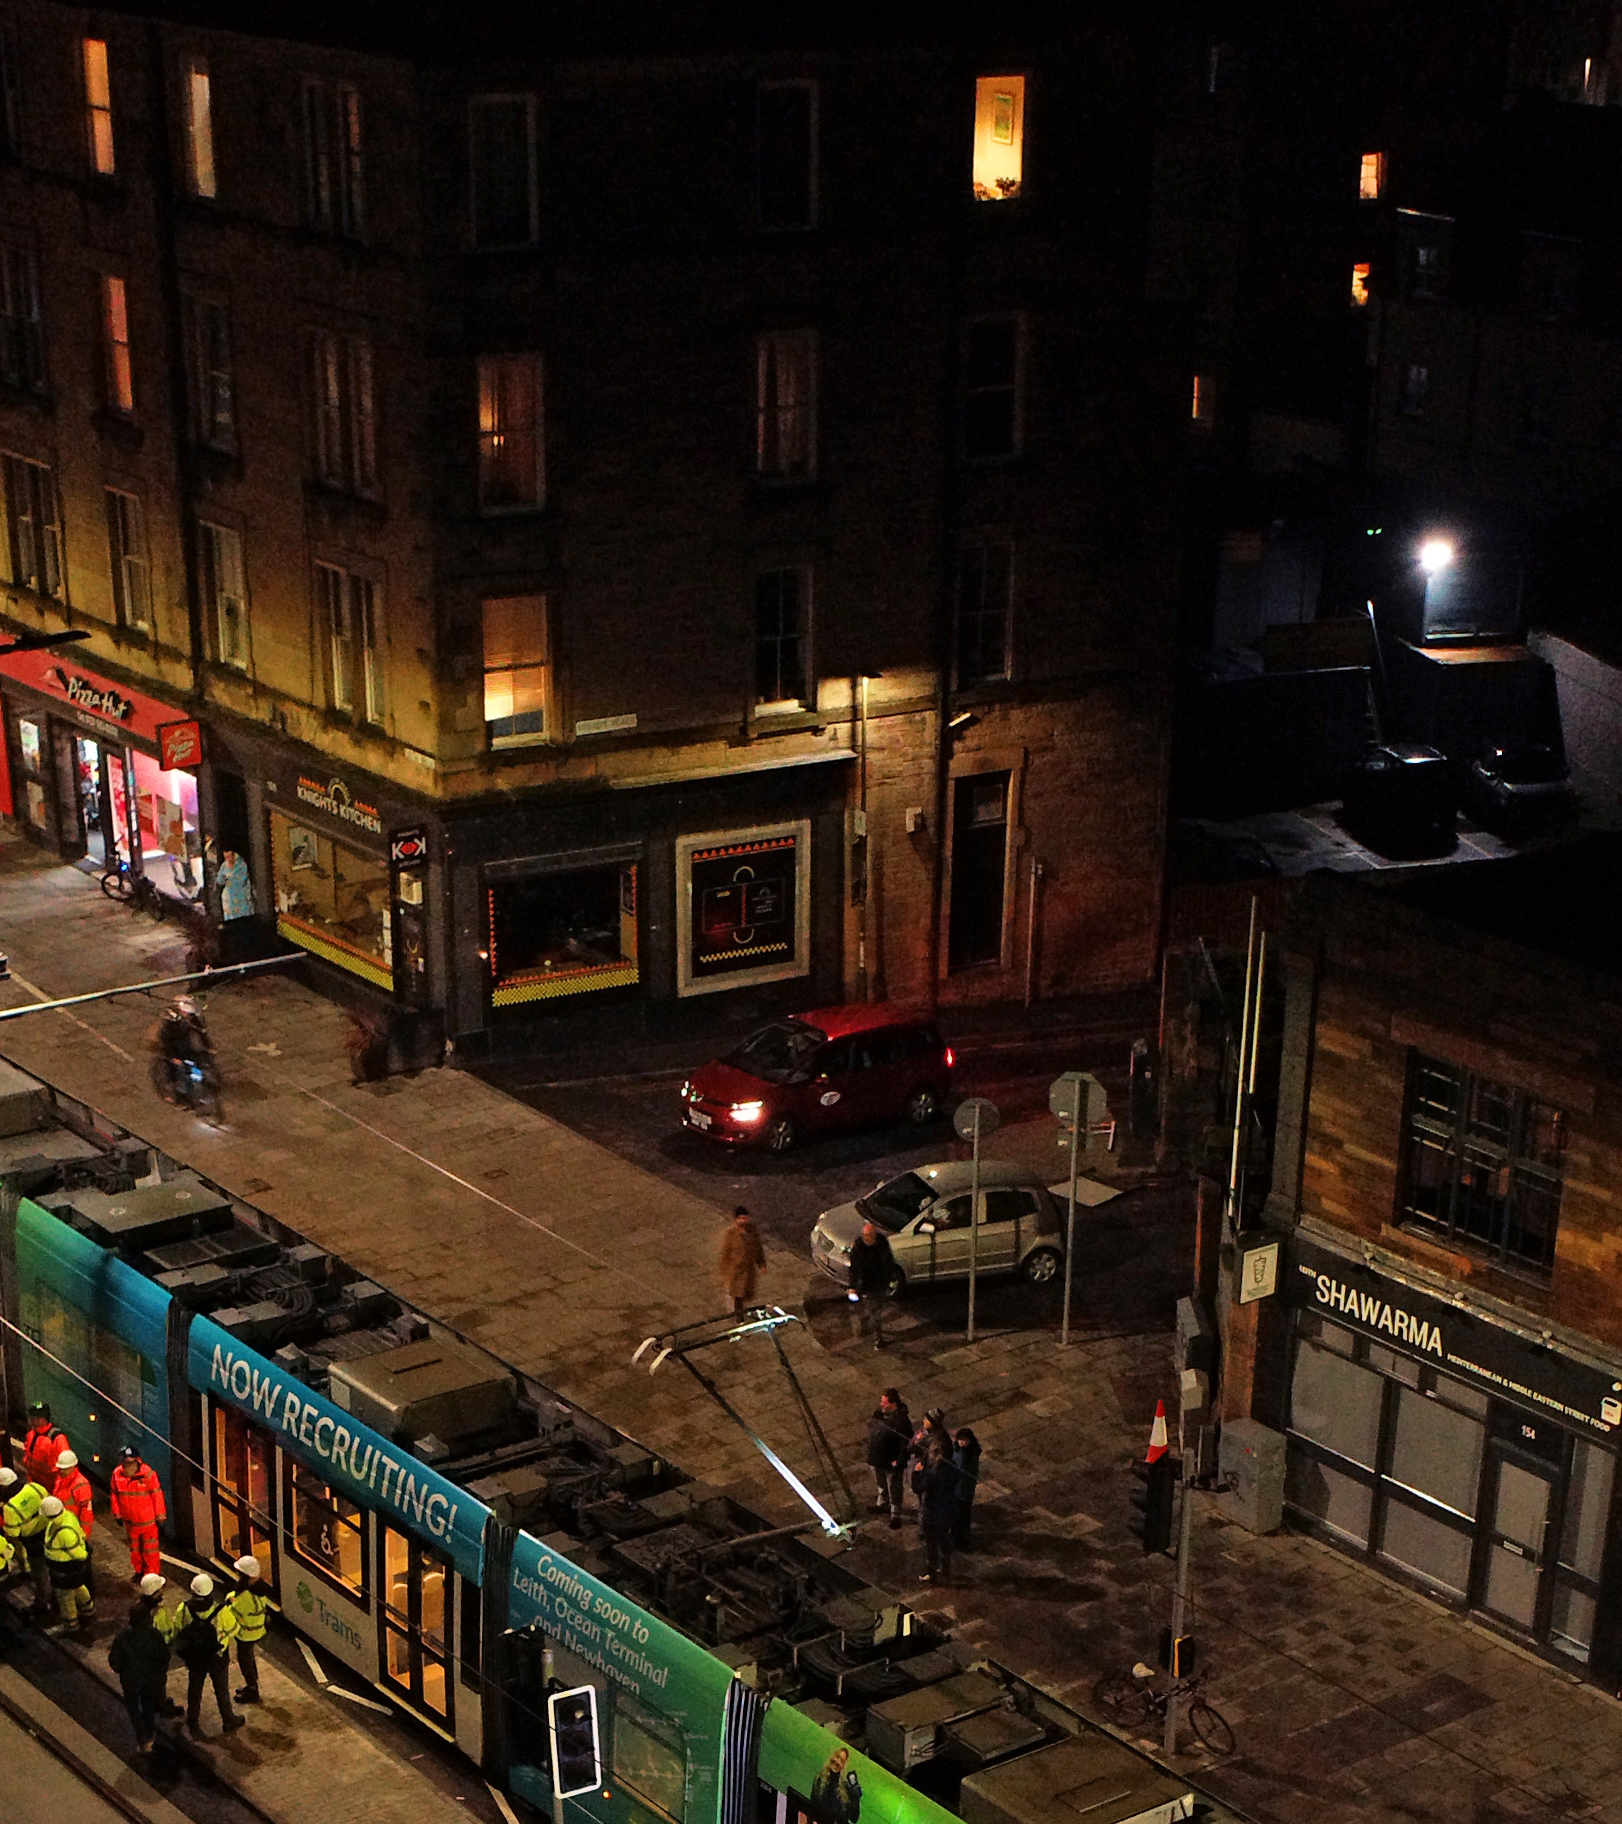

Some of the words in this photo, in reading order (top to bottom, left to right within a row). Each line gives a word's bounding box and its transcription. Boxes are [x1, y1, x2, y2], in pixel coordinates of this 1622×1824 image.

[67, 676, 101, 708] Pizza
[101, 692, 128, 719] Hut
[296, 785, 339, 815] KNIGHTS
[339, 804, 382, 834] KITCHEN
[1315, 1274, 1443, 1358] SHAWARMA
[211, 1343, 283, 1420] NOW
[281, 1391, 459, 1543] RECRUITING!
[316, 1596, 362, 1650] Trams
[512, 1566, 552, 1612] Leith,
[554, 1596, 603, 1643] Ocean
[604, 1627, 670, 1689] Terminal
[536, 1554, 594, 1611] Coming
[593, 1597, 631, 1633] soon
[632, 1618, 651, 1645] to
[533, 1614, 562, 1641] and
[564, 1629, 641, 1696] Newhaven
